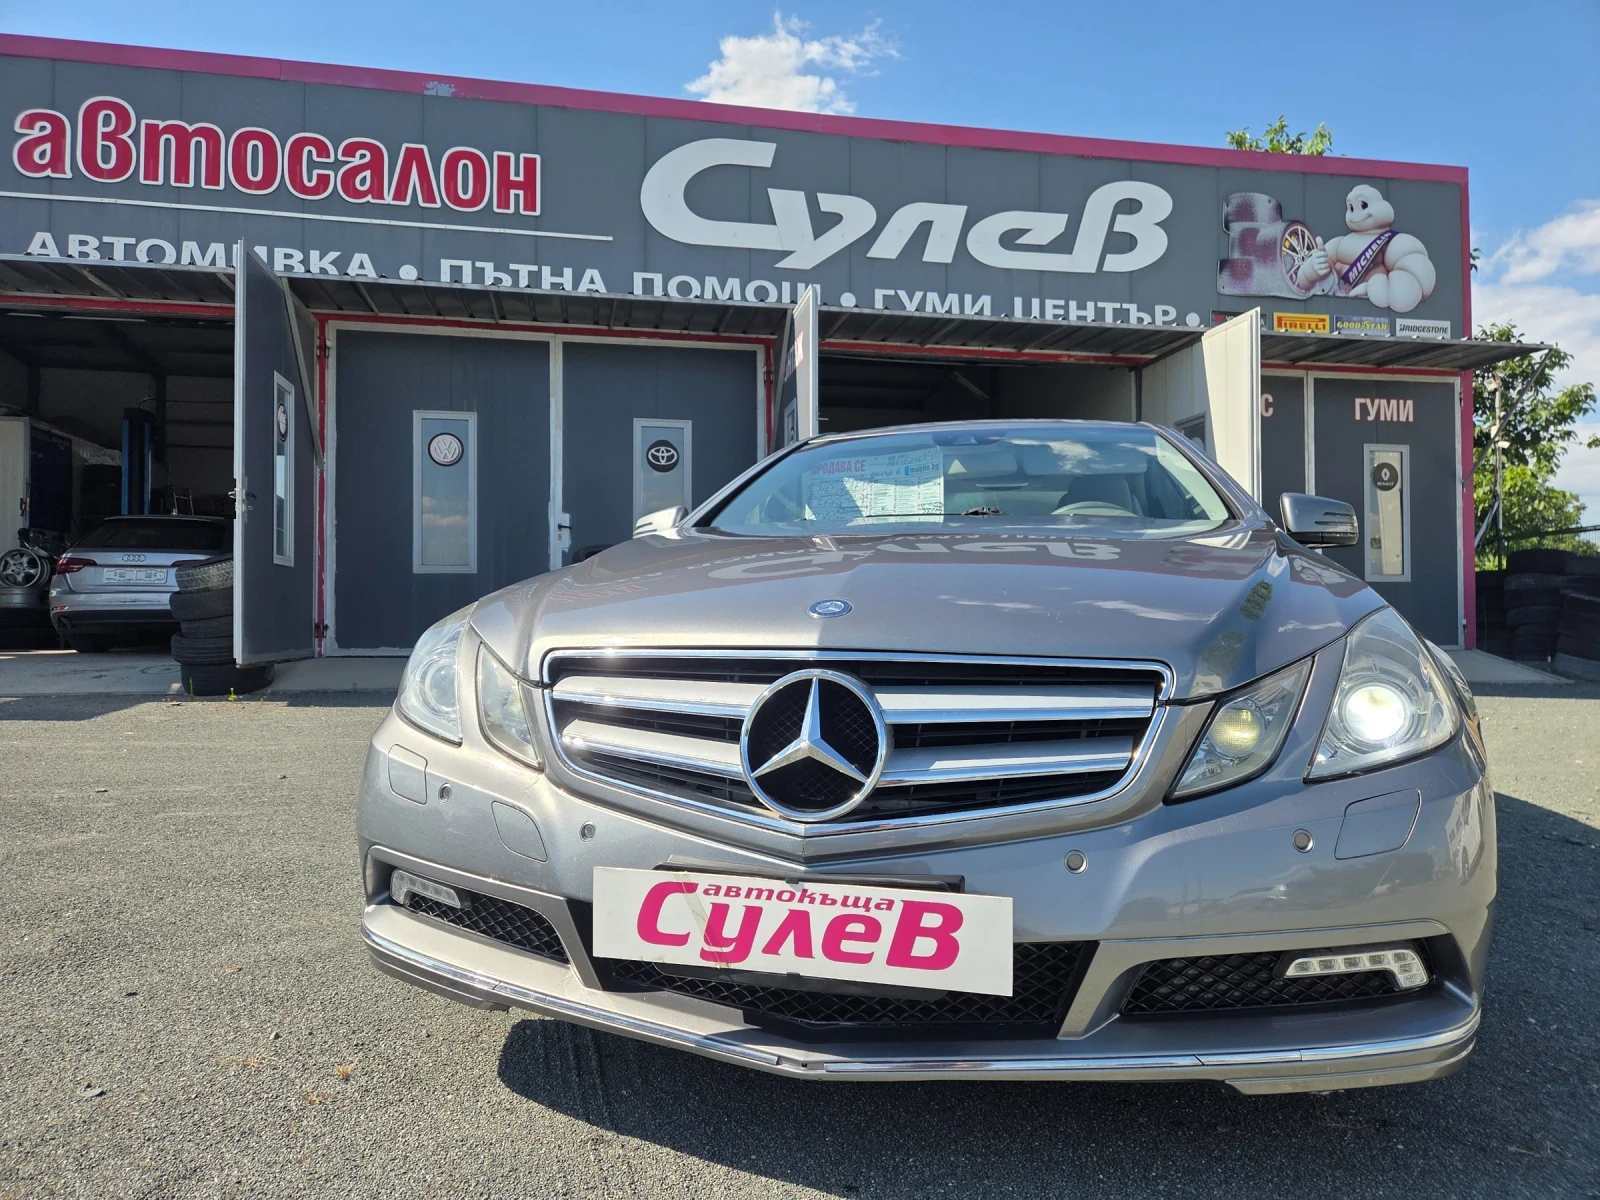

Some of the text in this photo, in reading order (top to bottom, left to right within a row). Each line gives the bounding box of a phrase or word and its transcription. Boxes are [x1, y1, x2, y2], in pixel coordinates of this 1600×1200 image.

[13, 95, 541, 216] автосалон
[1349, 232, 1392, 283] MICHELIN
[440, 259, 608, 293] ПЪТНА
[874, 288, 992, 317] ГУМИ
[1014, 297, 1177, 327] ЦЕНТЪР
[1276, 315, 1327, 331] PIRELLI
[1399, 323, 1449, 334] BRIDGESTONE
[1354, 397, 1414, 422] ГУМИ
[811, 459, 866, 476] ПРОДАВА СЕ
[909, 463, 939, 474] mobile.bg
[703, 883, 895, 913] автокъща
